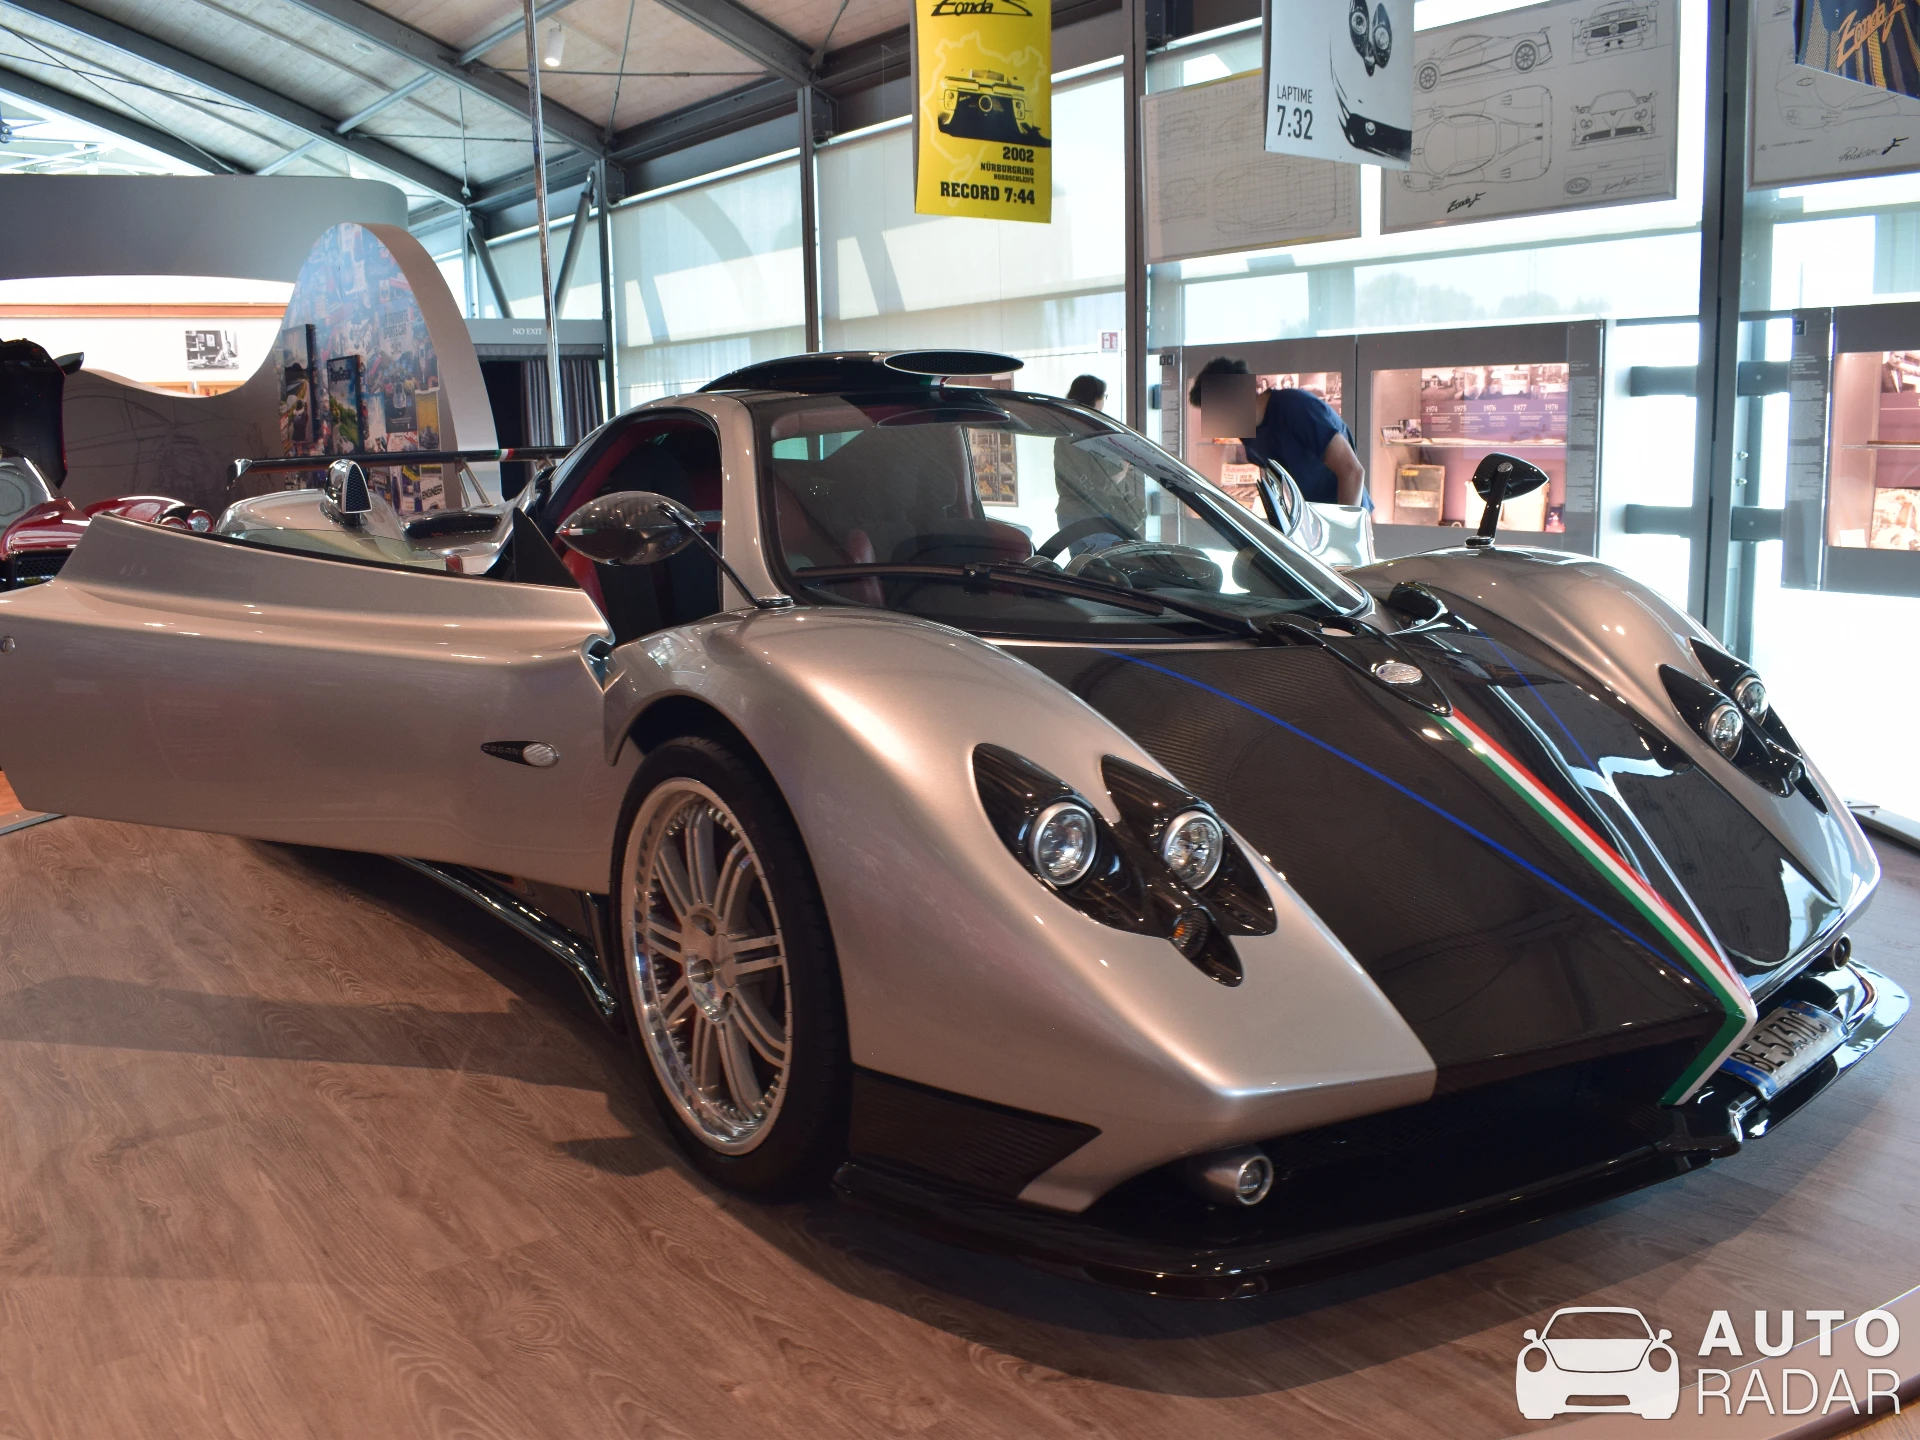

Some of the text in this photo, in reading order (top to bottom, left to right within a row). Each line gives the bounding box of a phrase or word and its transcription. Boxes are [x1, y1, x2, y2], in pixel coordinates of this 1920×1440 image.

[1836, 0, 1887, 68] Zonda
[1277, 84, 1313, 104] LAPTIME
[1277, 105, 1313, 140] 7:32
[1002, 146, 1034, 163] 2002
[980, 161, 1034, 176] NÜRBURGRING
[940, 181, 1035, 204] RECORD 7:44
[512, 327, 542, 335] NO EXIT
[1425, 403, 1559, 413] 1974 1975 1976 1977 1978
[421, 484, 443, 500] ENGINEER
